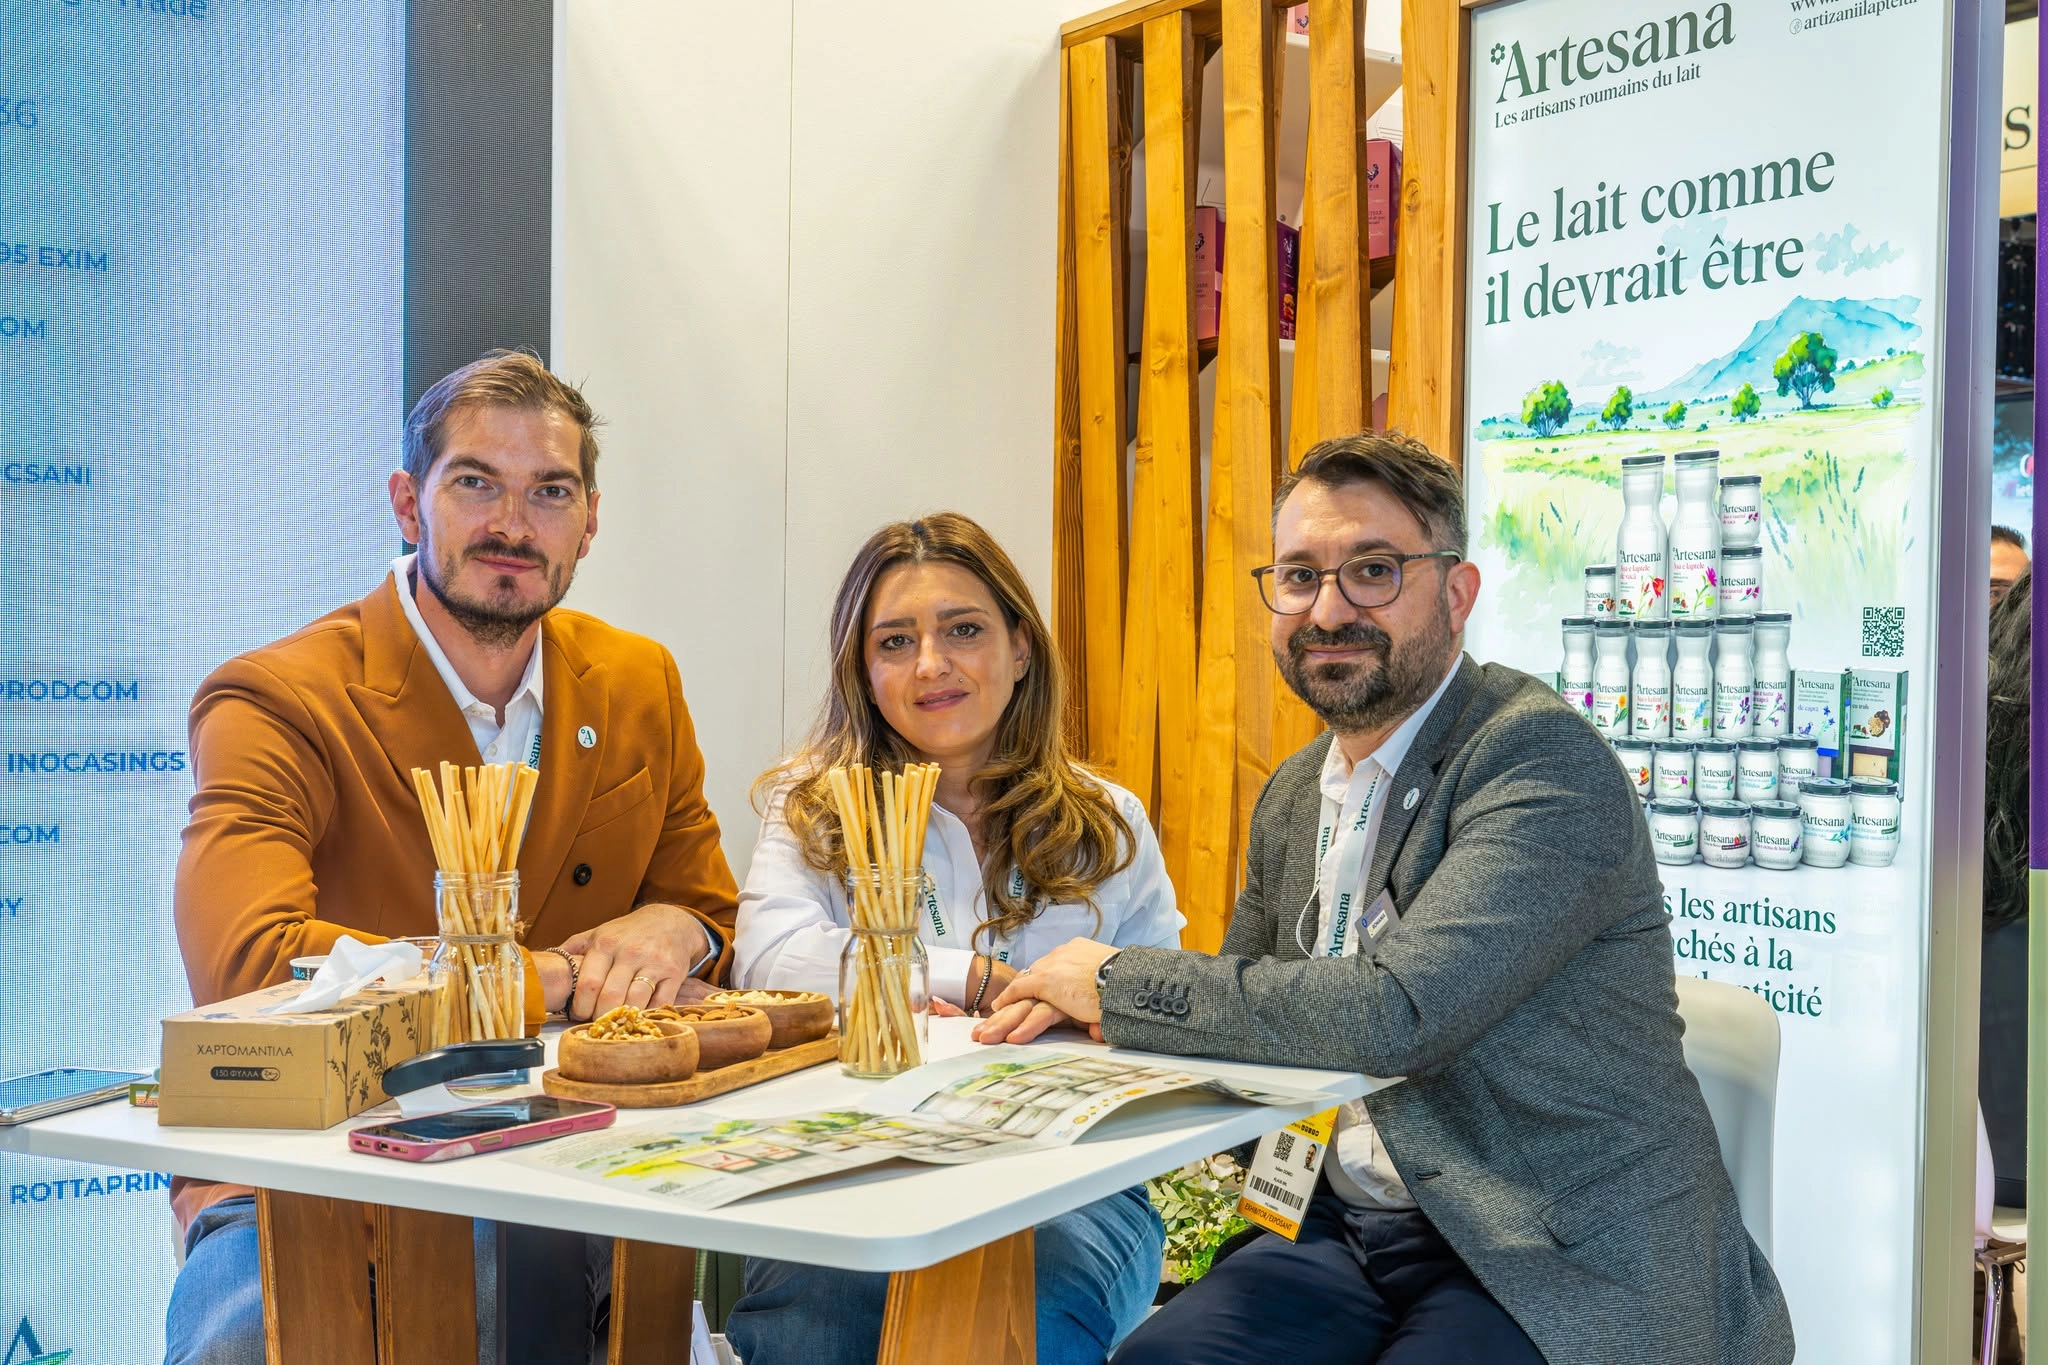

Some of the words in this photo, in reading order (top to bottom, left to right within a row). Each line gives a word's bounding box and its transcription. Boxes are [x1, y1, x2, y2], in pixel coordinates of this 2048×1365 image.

[1495, 2, 1737, 104] Artesana
[1495, 109, 1518, 129] Les
[1521, 94, 1576, 123] artisans
[1579, 79, 1649, 108] roumains
[1652, 70, 1672, 90] du
[1676, 63, 1702, 86] lait
[2003, 105, 2031, 152] S
[1486, 202, 1540, 255] Le
[1553, 181, 1627, 243] lait
[1641, 150, 1836, 226] comme
[38, 247, 108, 272] EXIM
[1484, 270, 1510, 327] il
[1523, 245, 1687, 318] devrait
[1702, 235, 1805, 291] être
[1723, 504, 1756, 514] Artesana
[1620, 551, 1661, 563] Artesana
[1673, 548, 1716, 561] Artesana
[1720, 576, 1756, 587] Artesana
[1562, 679, 1592, 690] Artesana
[1597, 683, 1627, 694] Artesana
[1718, 683, 1750, 694] Artesana
[1754, 679, 1787, 689] Artesana
[1799, 679, 1835, 690] Artesana
[1853, 677, 1890, 689] Artesana
[1637, 684, 1668, 696] Artesana
[1676, 684, 1708, 696] Artesana
[7, 752, 186, 773] INOCASINGS
[1660, 767, 1688, 776] Artesana
[1702, 767, 1731, 777] Artesana
[1741, 767, 1773, 777] Artesana
[1781, 765, 1812, 775] Artesana
[1804, 813, 1845, 827] Artesana
[1852, 813, 1893, 827] Artesana
[1656, 830, 1686, 842] Artesana
[1704, 832, 1734, 845] Artesana
[1755, 832, 1790, 845] Artesana
[0, 897, 22, 919] Y
[1680, 888, 1714, 921] les
[1722, 897, 1836, 934] artisans
[1330, 893, 1351, 957] Artesana
[1671, 929, 1735, 964] chés
[1743, 936, 1759, 967] à
[1768, 938, 1793, 971] la
